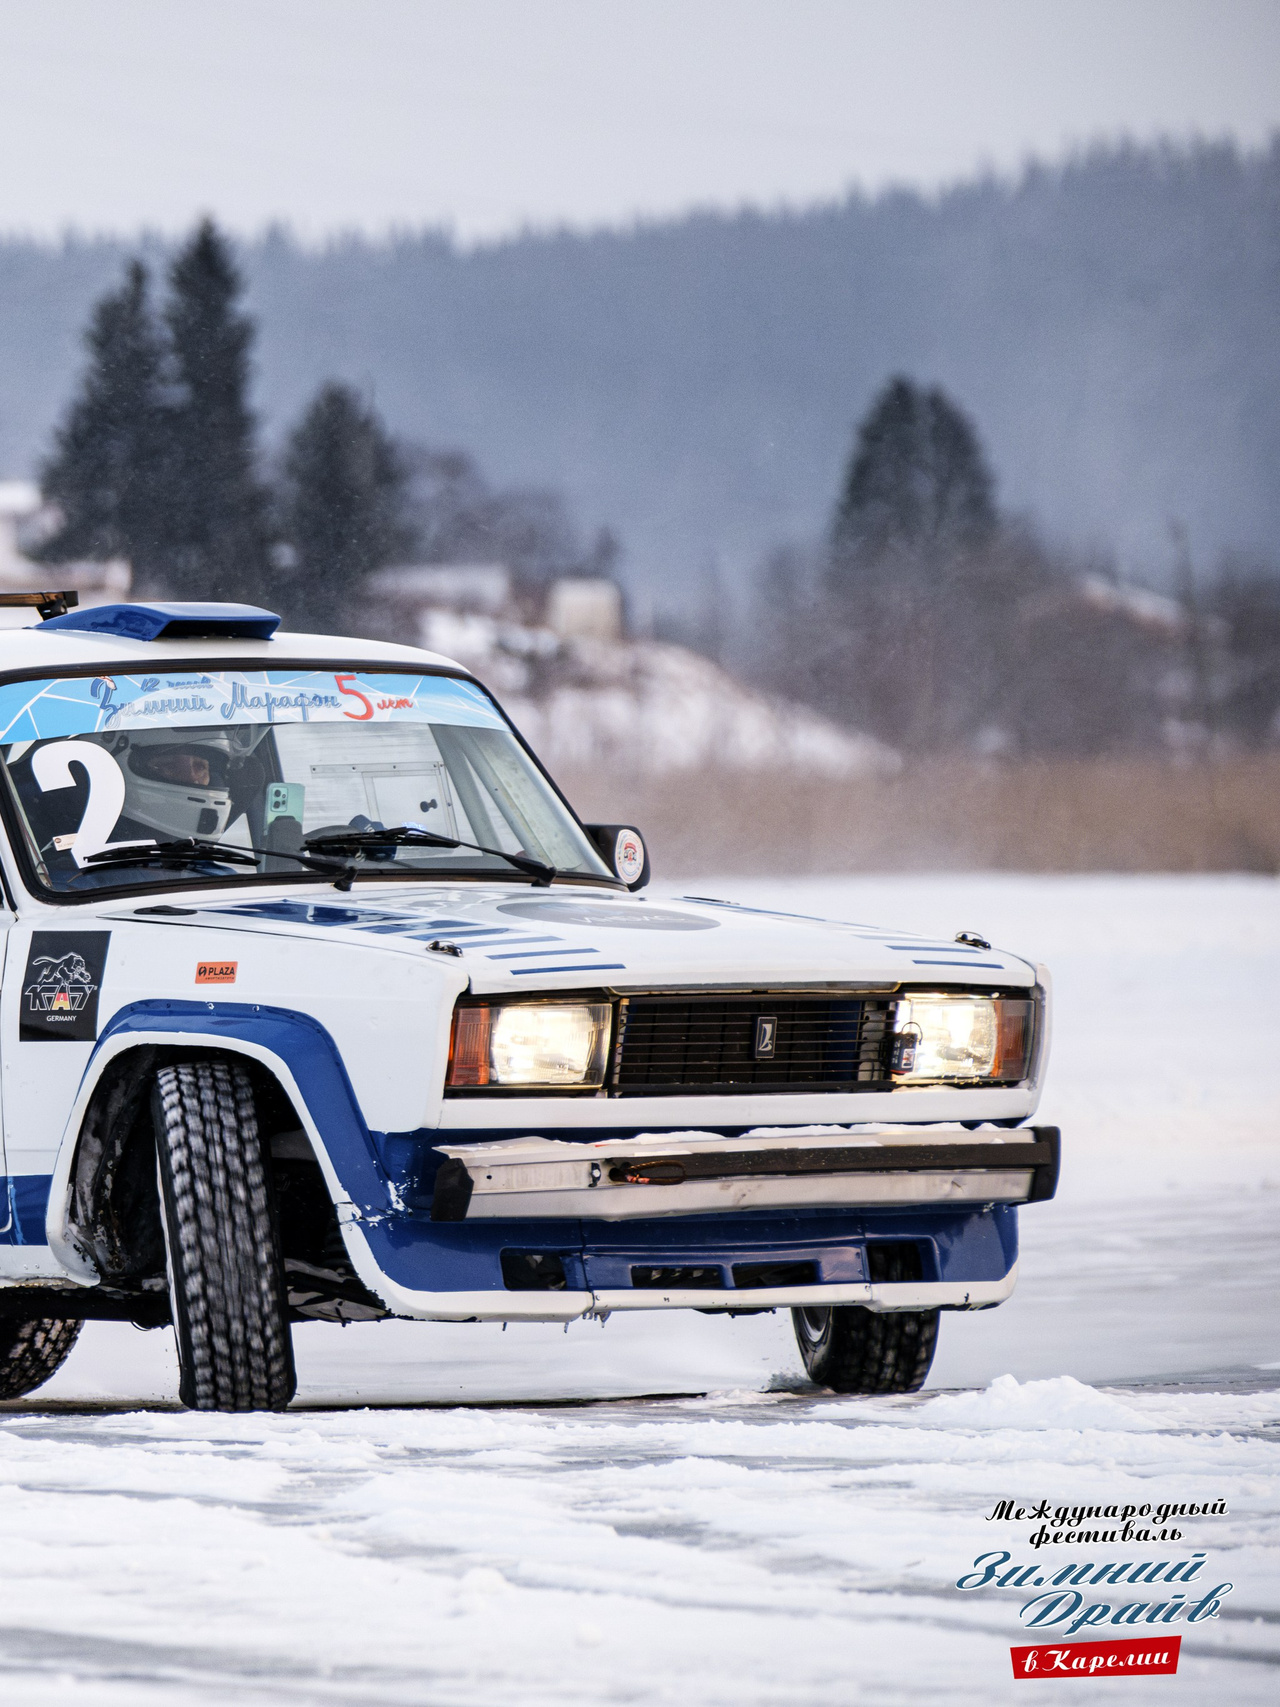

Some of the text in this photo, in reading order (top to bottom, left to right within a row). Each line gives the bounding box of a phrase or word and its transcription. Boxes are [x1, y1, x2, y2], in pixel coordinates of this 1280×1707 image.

[140, 677, 160, 692] 12
[220, 681, 342, 721] Марафон
[334, 674, 374, 721] 5
[377, 697, 414, 711] лет
[31, 740, 157, 869] 2
[208, 966, 235, 976] PLAZA
